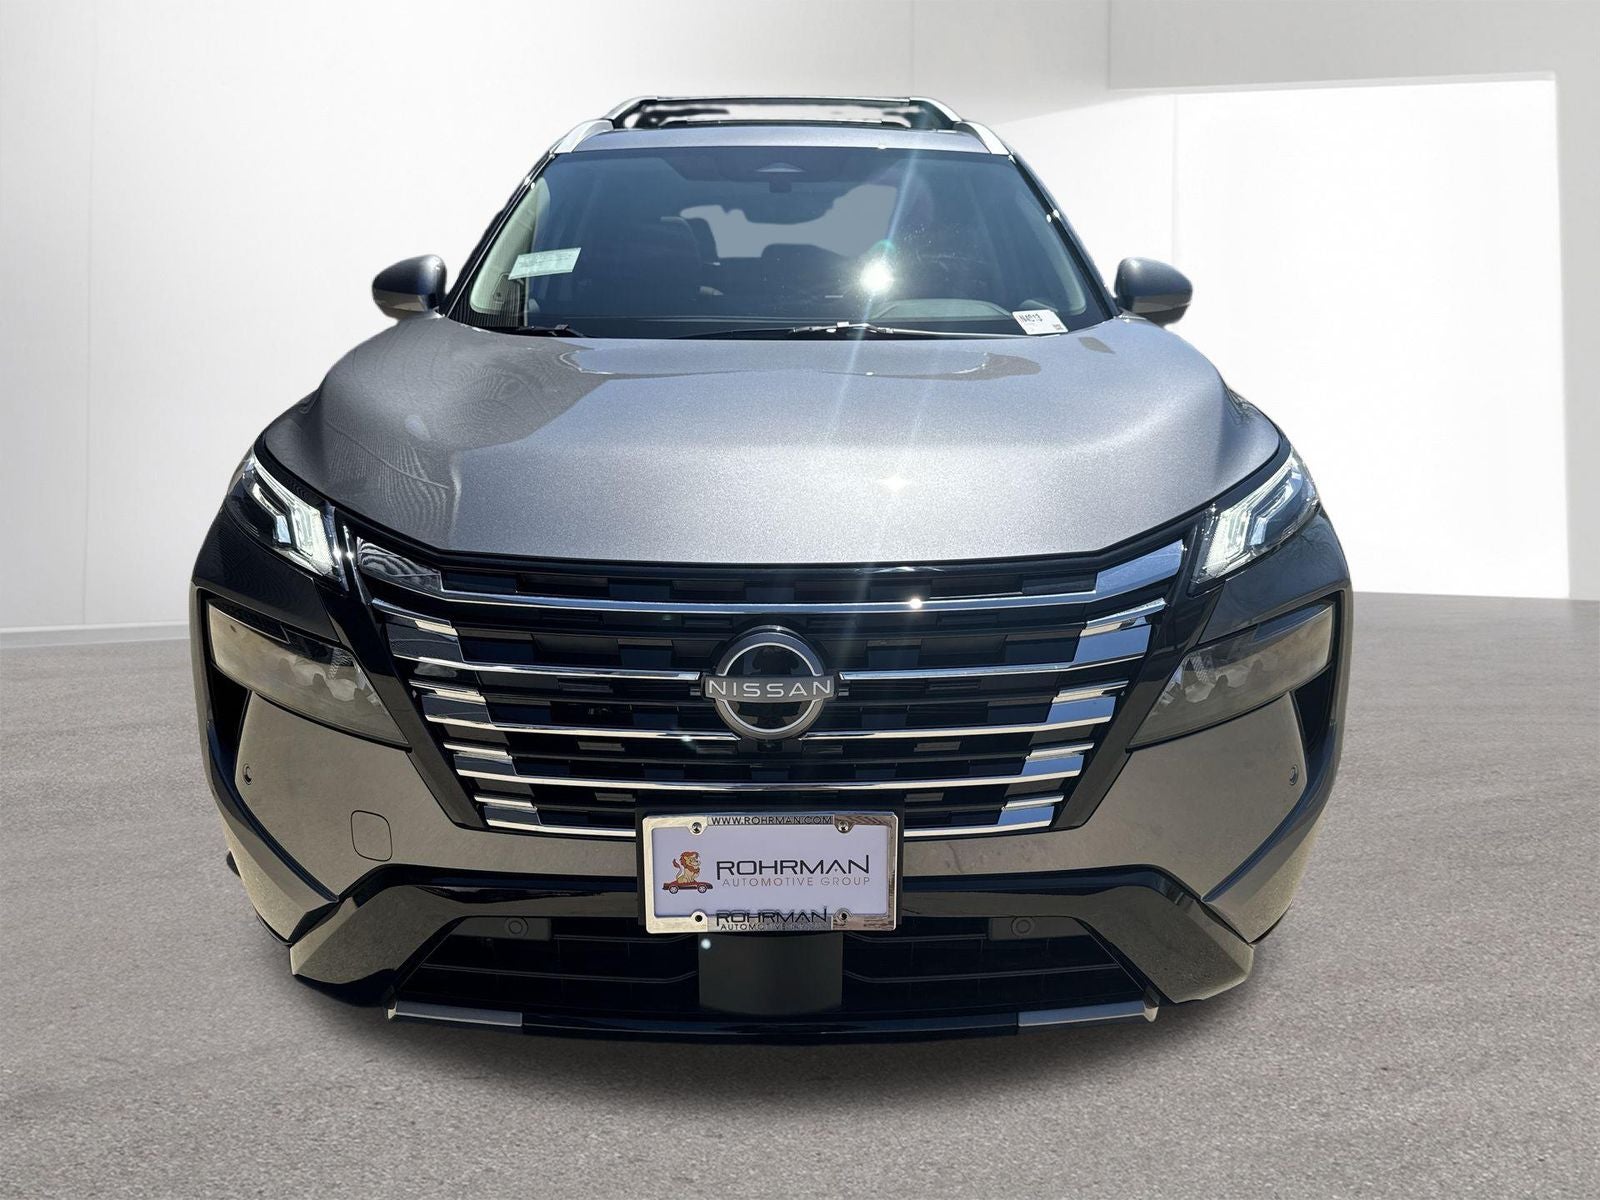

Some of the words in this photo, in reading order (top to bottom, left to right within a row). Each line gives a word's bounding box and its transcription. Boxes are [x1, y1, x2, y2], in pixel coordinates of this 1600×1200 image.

[709, 680, 831, 697] NISSAN
[711, 815, 832, 825] WWW.ROHRMAN.COM
[716, 855, 870, 880] ROHRMAN
[722, 877, 814, 888] AUTOMOTIVE
[821, 876, 870, 886] GROUP
[716, 907, 828, 926] ROHRMAN
